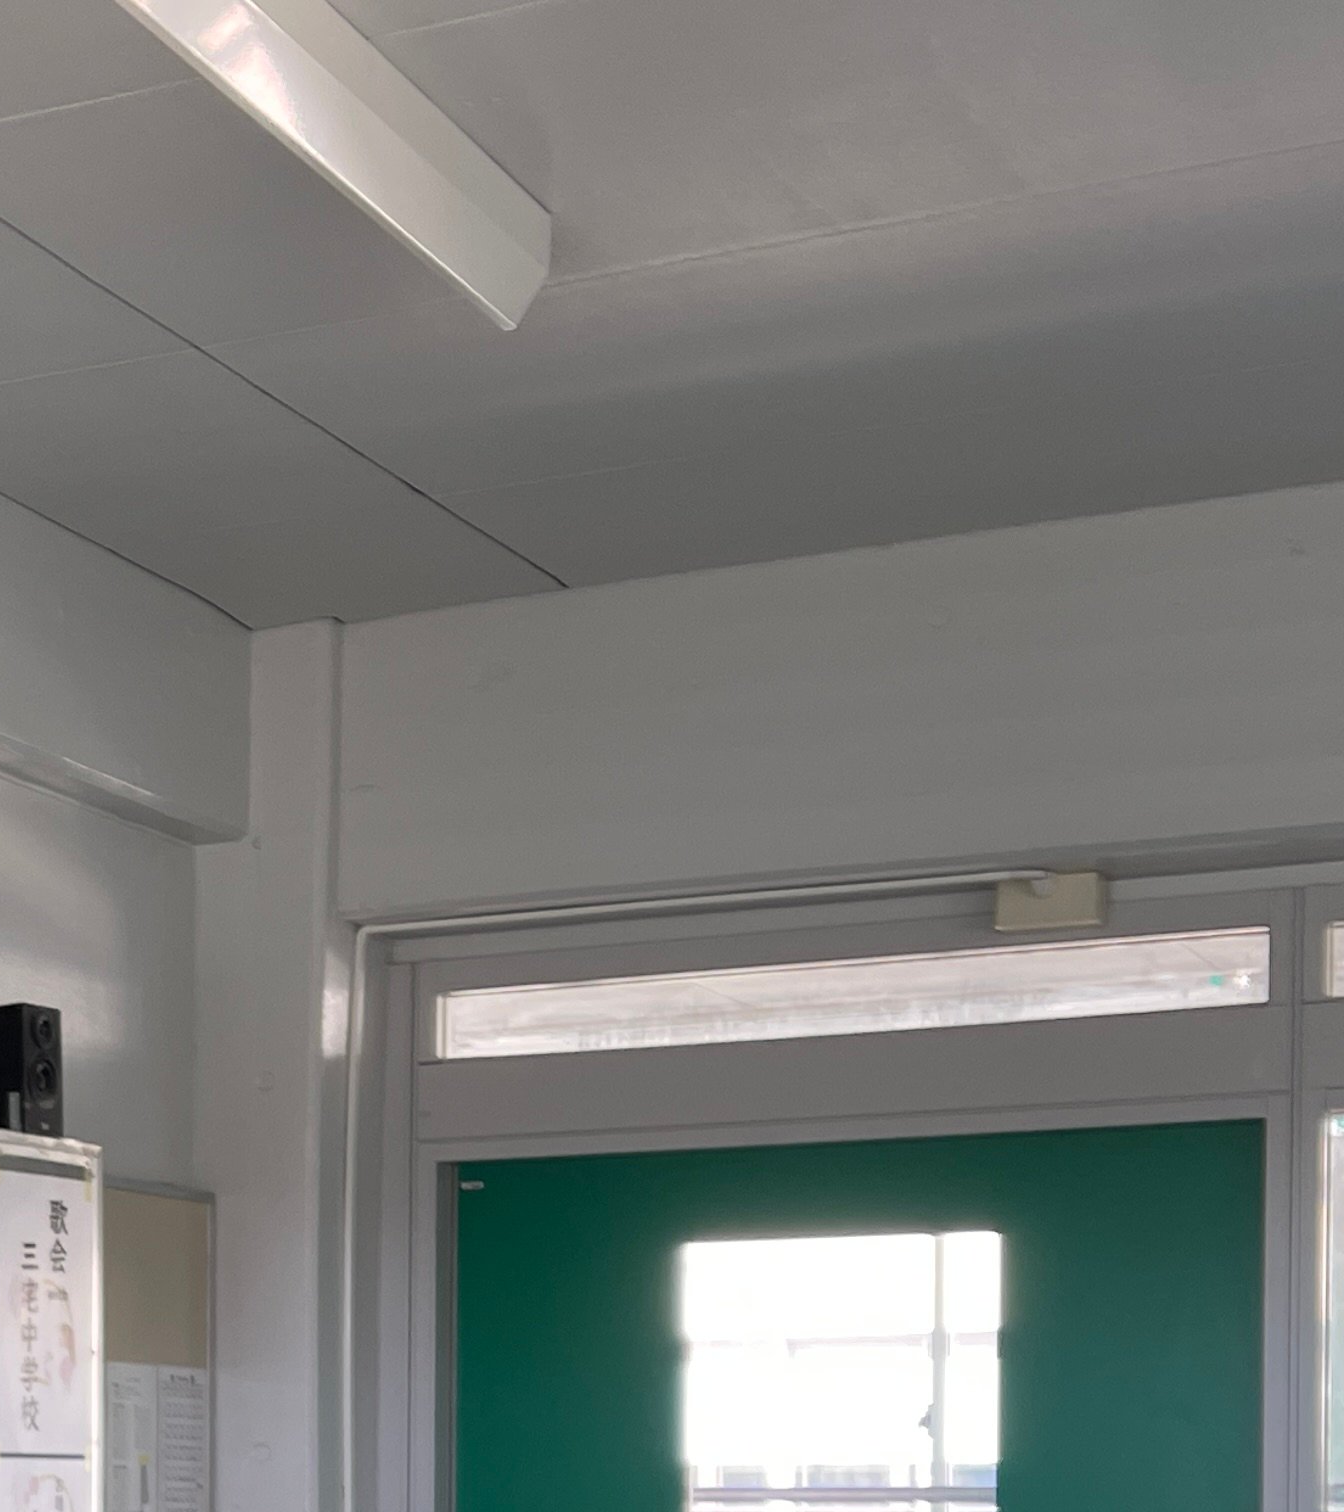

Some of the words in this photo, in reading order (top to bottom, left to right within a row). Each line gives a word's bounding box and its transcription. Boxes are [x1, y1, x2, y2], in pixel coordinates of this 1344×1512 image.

[49, 1199, 69, 1274] 歌会
[19, 1241, 40, 1432] 三宅中学校
